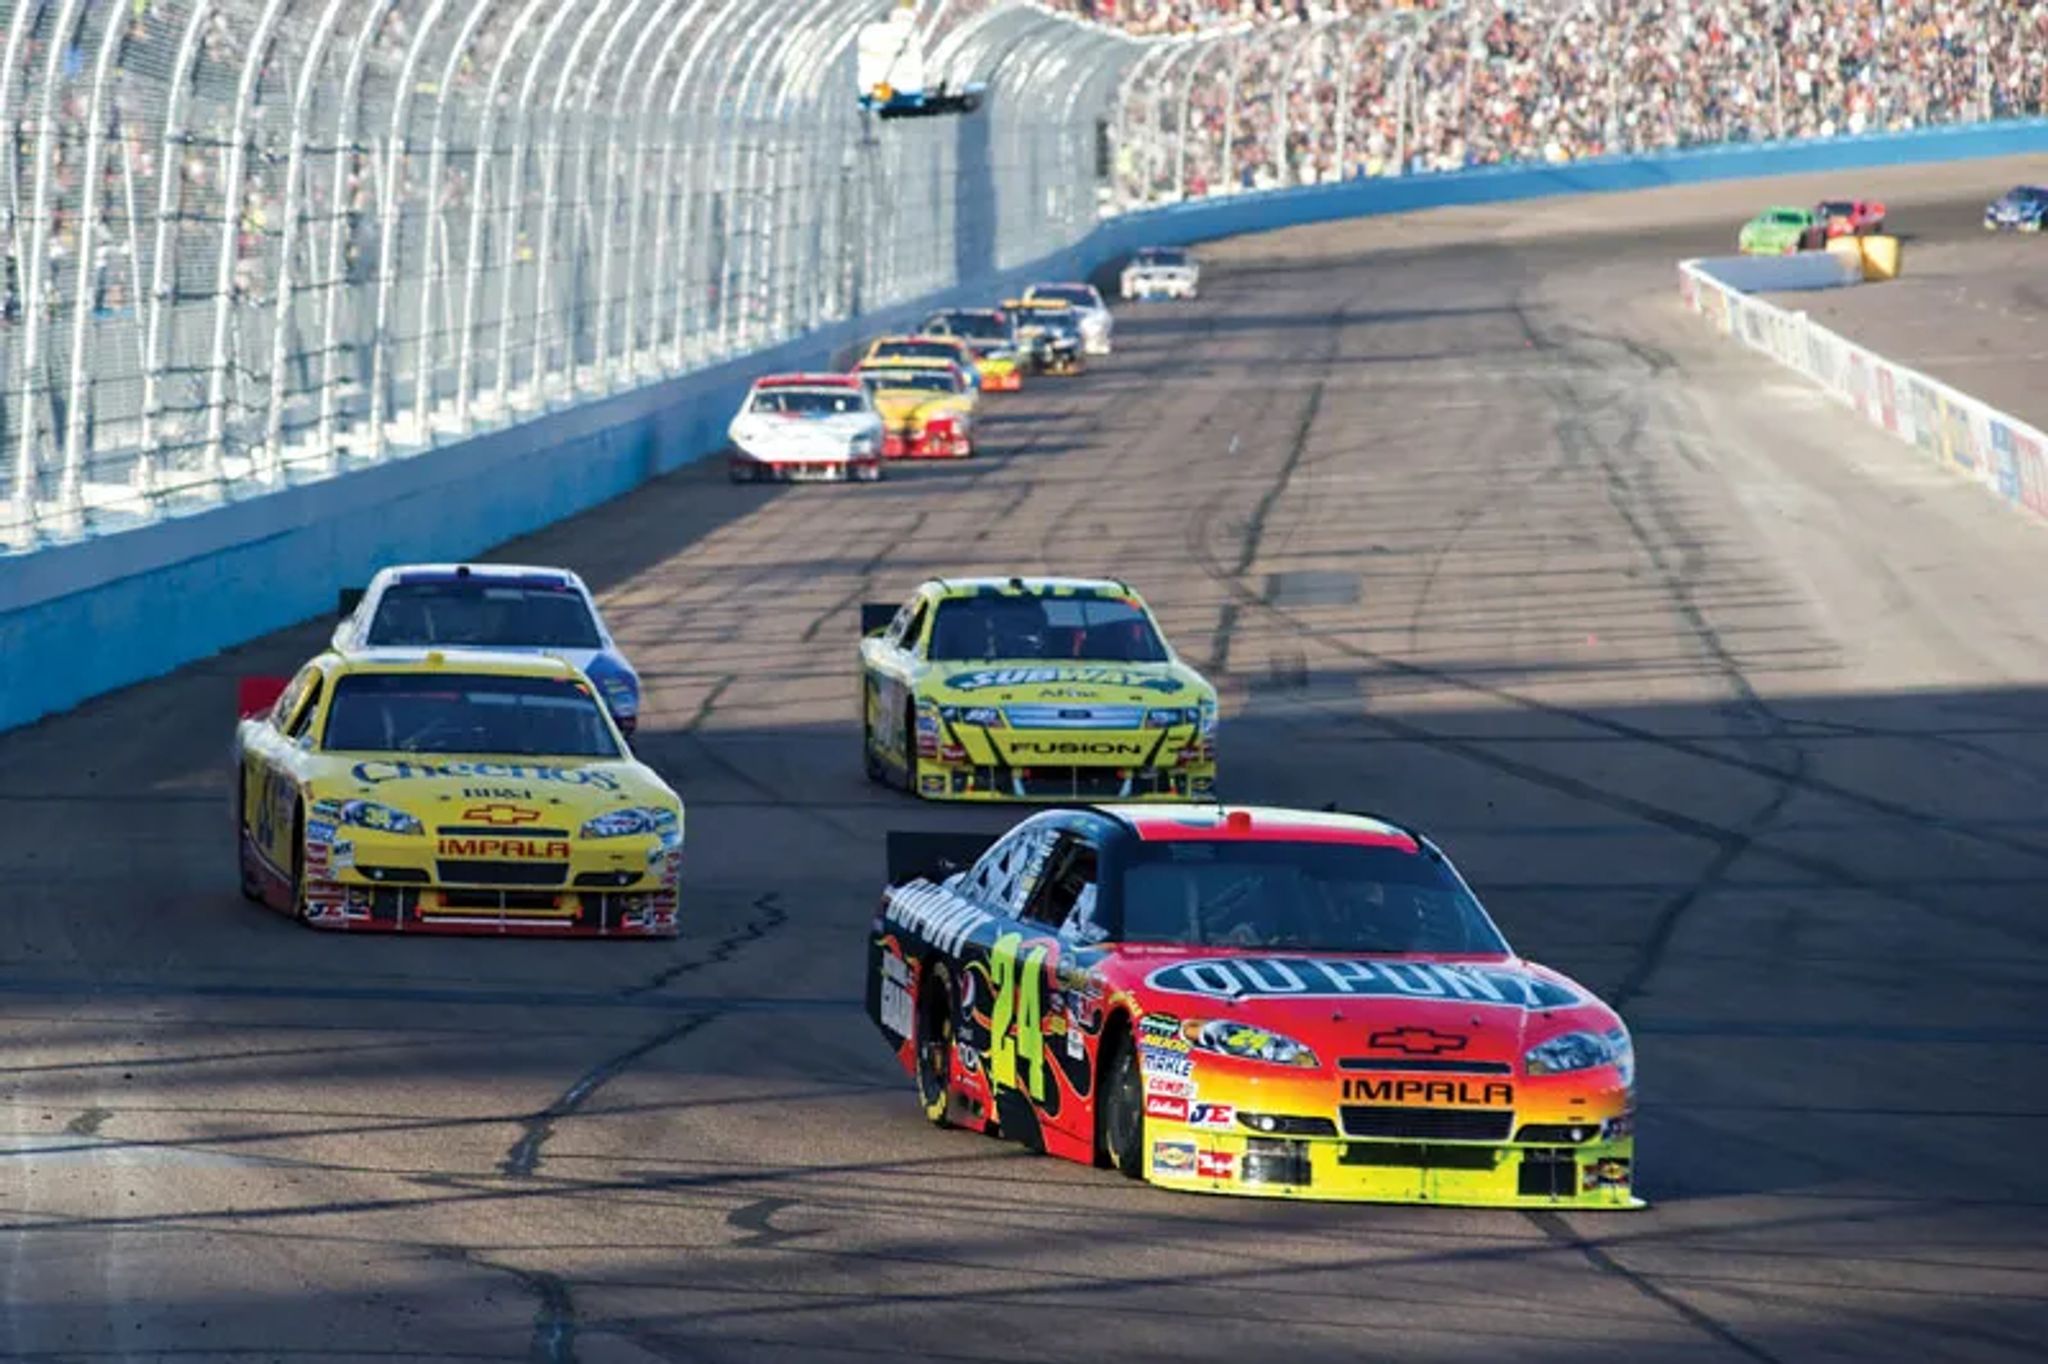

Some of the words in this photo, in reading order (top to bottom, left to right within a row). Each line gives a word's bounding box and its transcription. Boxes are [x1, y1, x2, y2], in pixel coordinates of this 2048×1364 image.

[1010, 742, 1141, 754] FUSION
[438, 839, 571, 858] IMPALA
[990, 932, 1045, 1102] 24
[1342, 1078, 1514, 1104] IMPALA
[1190, 1104, 1232, 1123] JE
